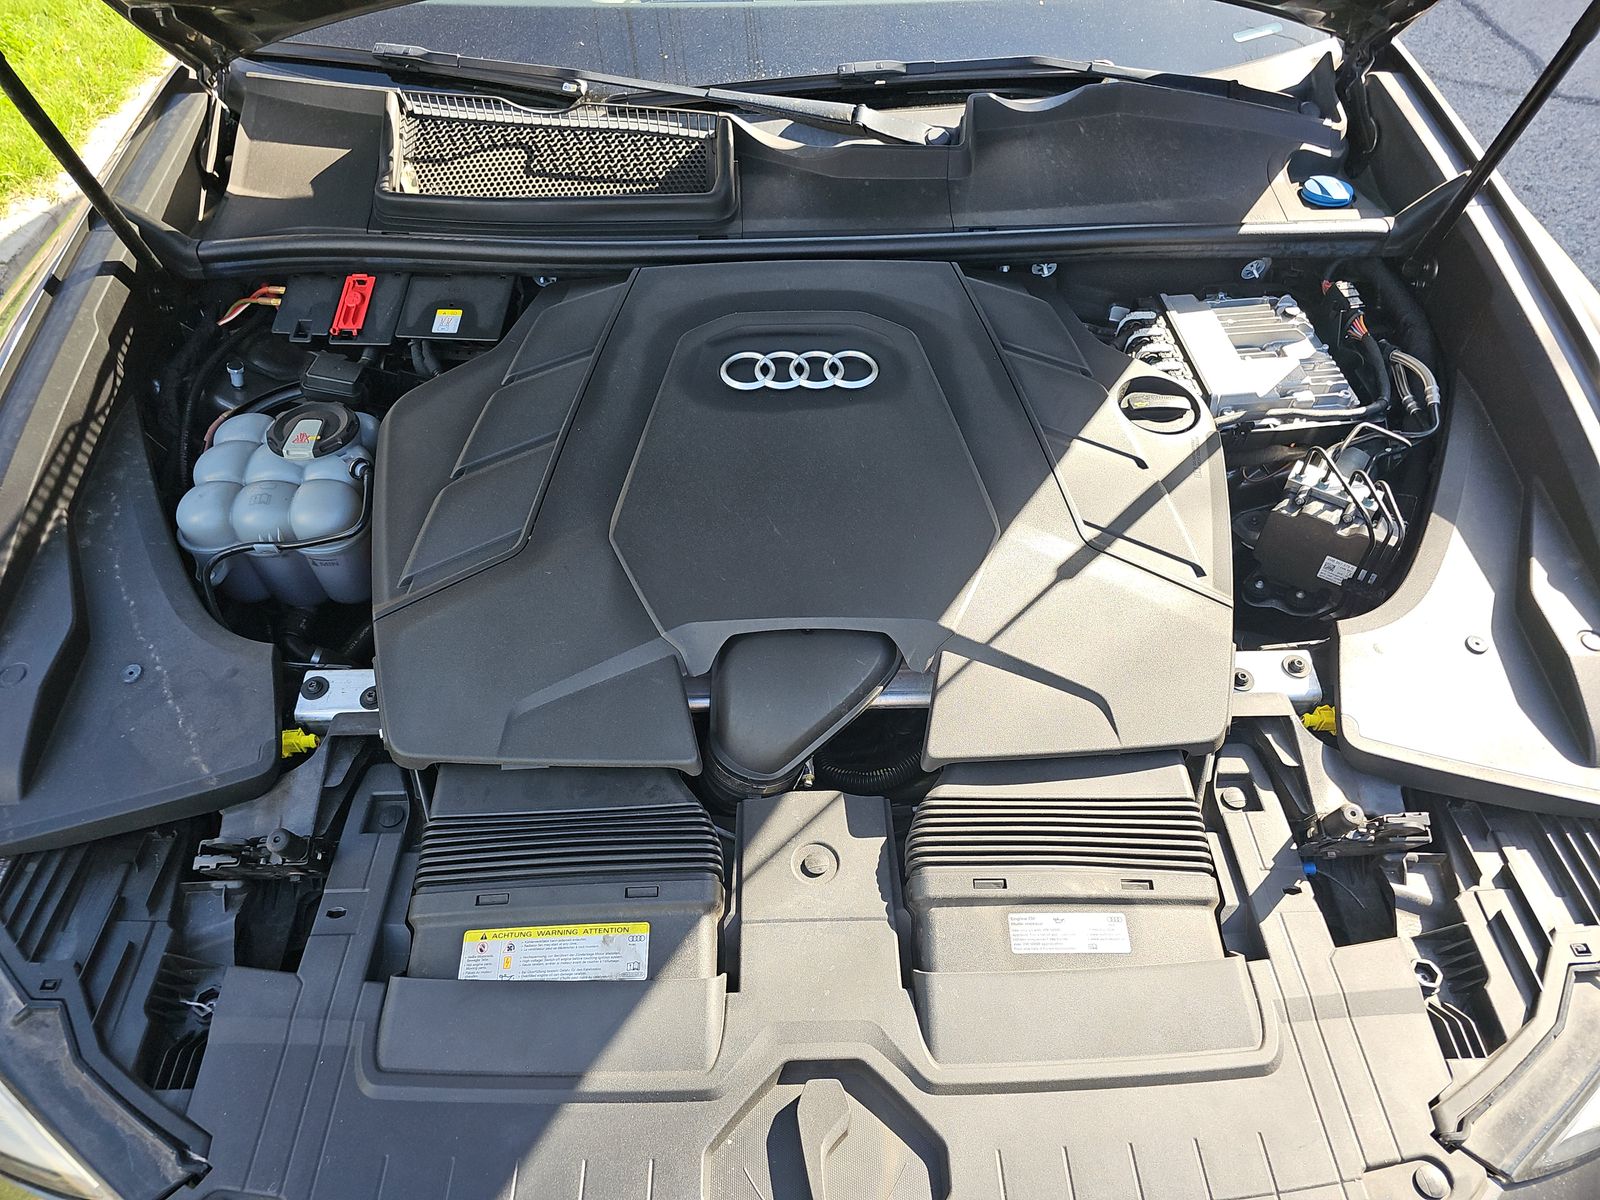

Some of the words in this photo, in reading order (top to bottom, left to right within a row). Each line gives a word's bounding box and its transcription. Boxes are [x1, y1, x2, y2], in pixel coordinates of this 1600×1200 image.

[491, 931, 533, 939] ACHTUNG
[536, 928, 579, 937] WARNING
[583, 926, 630, 935] ATTENTION
